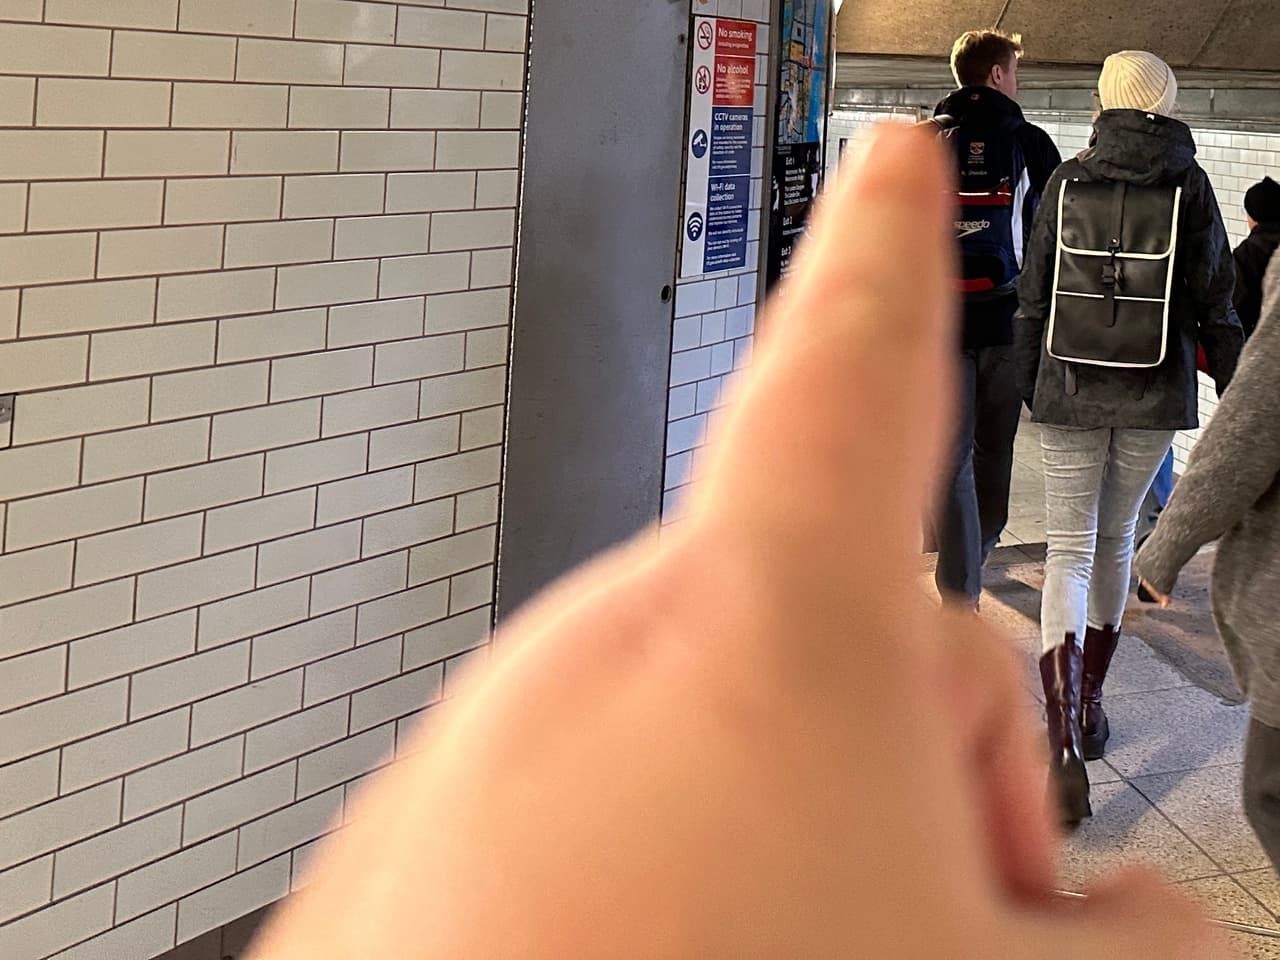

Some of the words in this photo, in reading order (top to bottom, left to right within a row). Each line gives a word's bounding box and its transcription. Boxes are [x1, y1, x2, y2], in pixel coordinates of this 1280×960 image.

[718, 28, 728, 38] No
[729, 29, 753, 42] smoking
[717, 64, 727, 73] No
[727, 64, 749, 75] alcohol
[714, 112, 729, 121] CCTV
[714, 123, 719, 131] in
[720, 124, 743, 133] operation
[711, 183, 724, 192] Wi-Fi
[724, 183, 736, 191] data
[710, 193, 735, 202] collection
